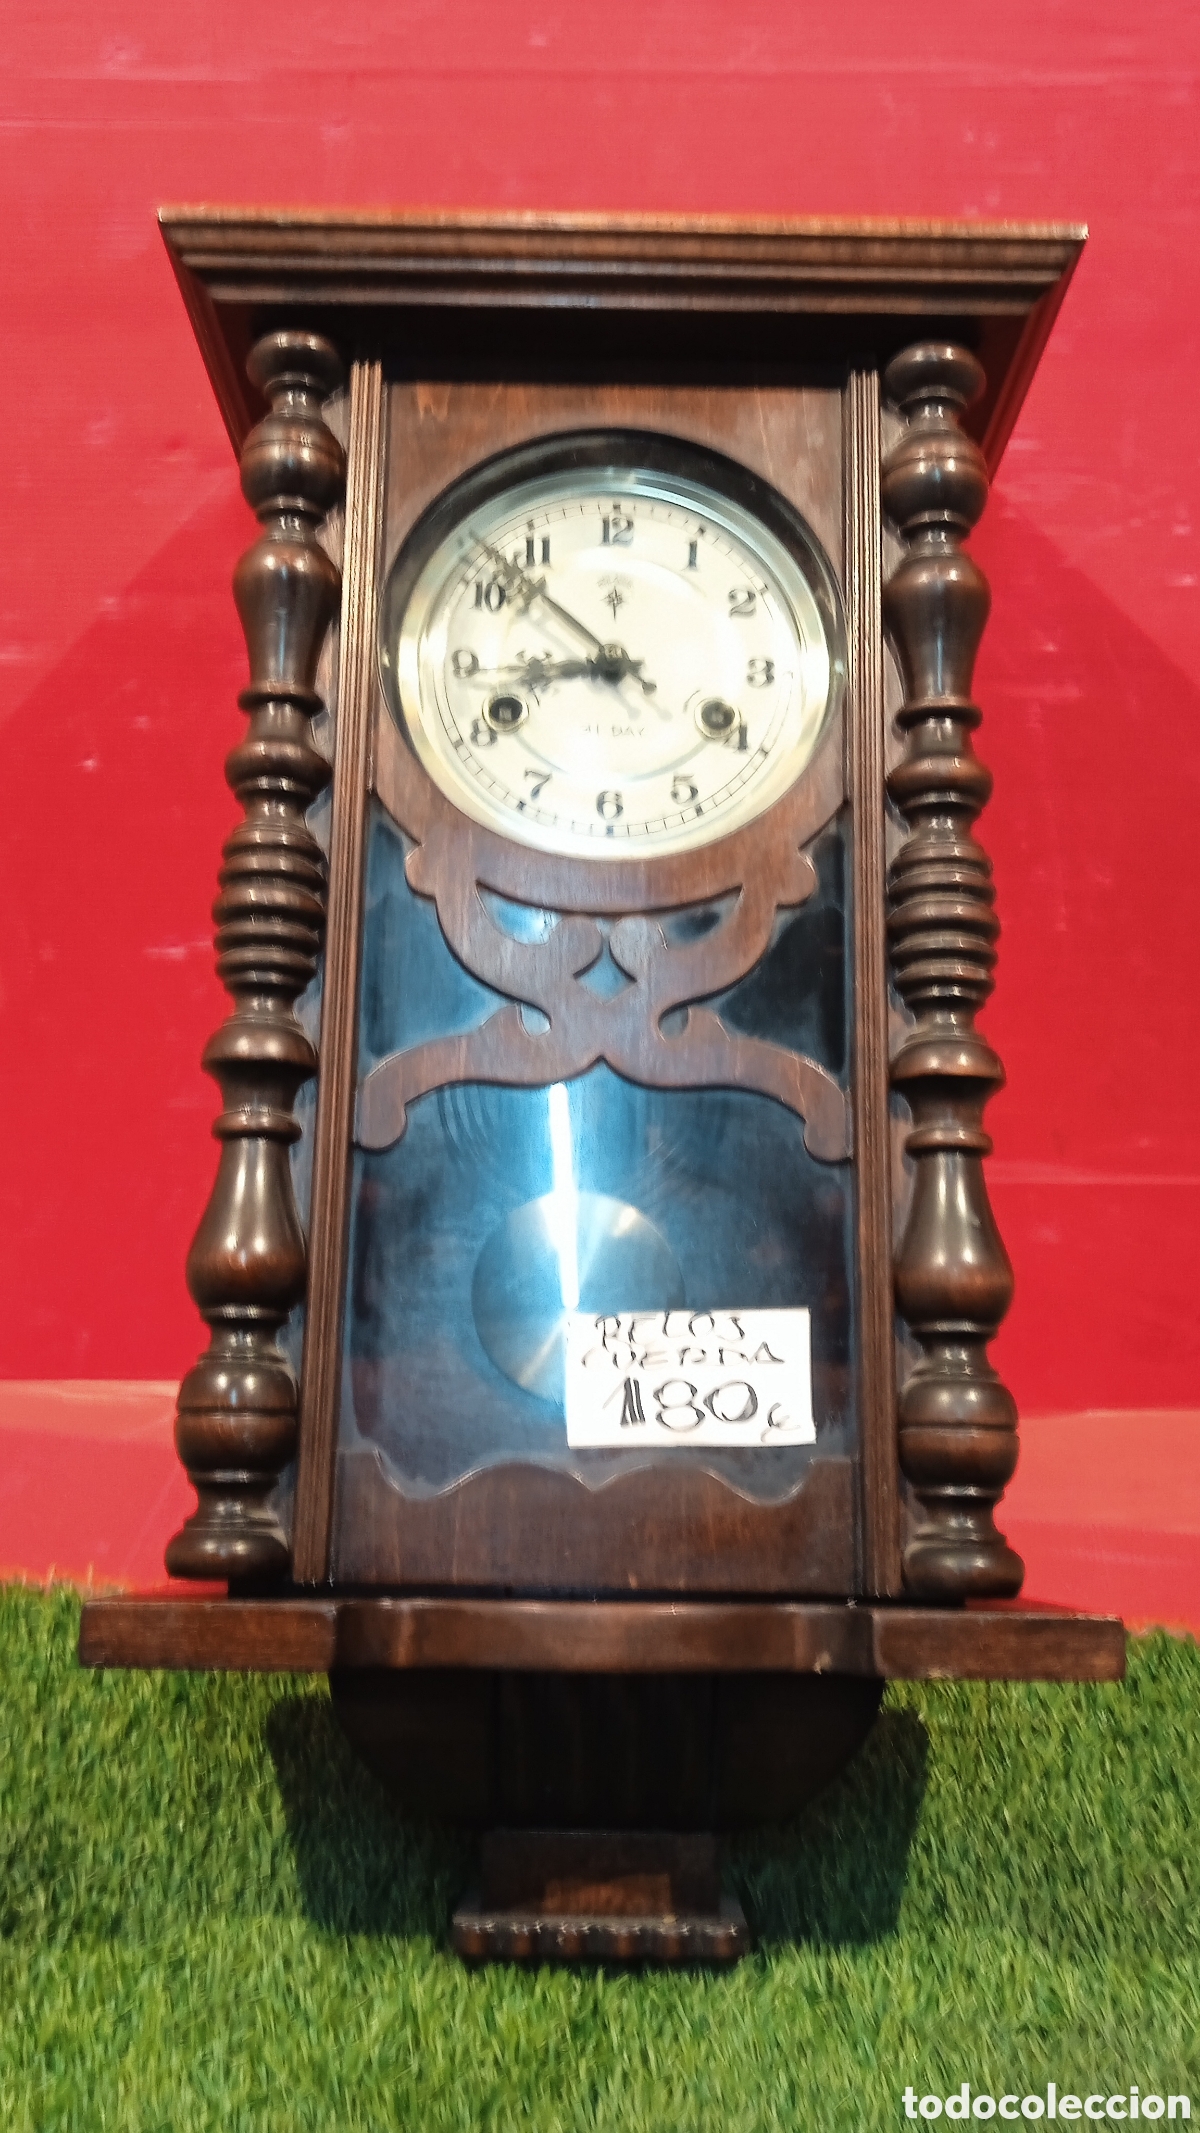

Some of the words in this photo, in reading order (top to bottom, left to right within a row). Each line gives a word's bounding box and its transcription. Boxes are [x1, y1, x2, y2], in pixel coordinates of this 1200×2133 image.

[599, 515, 635, 548] 12
[524, 534, 552, 569] 11
[685, 537, 699, 572] 1
[472, 580, 507, 614] 10
[727, 587, 758, 618] 2
[451, 648, 480, 680] 9
[746, 657, 776, 688] 3
[470, 717, 498, 749] 8
[523, 767, 553, 800] 7
[671, 771, 698, 804] 5
[595, 789, 624, 821] 6
